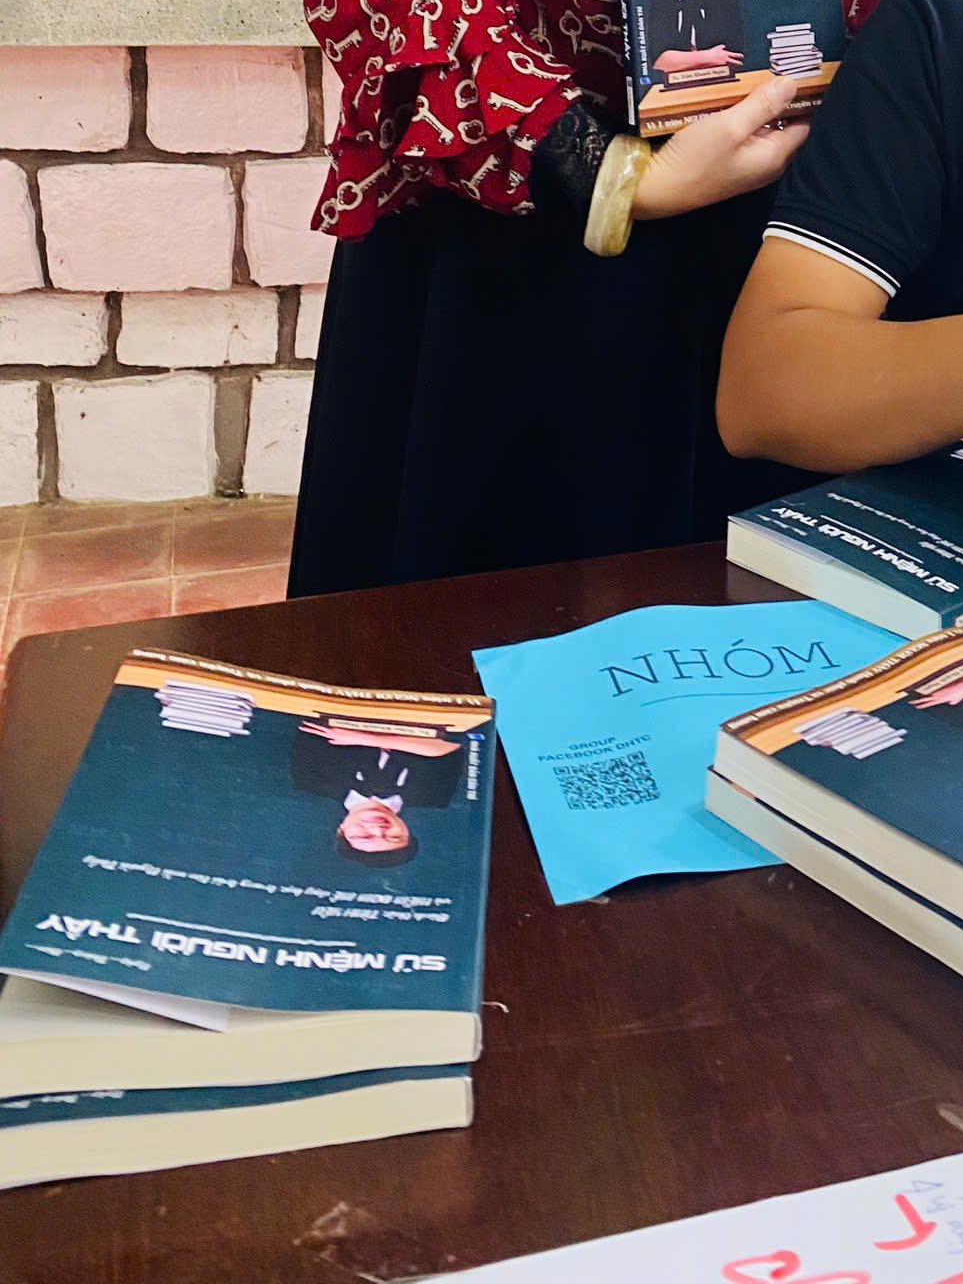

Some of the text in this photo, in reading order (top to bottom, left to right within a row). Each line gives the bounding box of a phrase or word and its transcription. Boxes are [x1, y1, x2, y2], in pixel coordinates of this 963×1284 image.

[873, 549, 929, 577] MỆNH
[600, 639, 840, 698] NHÓM
[538, 747, 613, 761] FACEBOOK
[568, 736, 616, 751] GROUP
[38, 915, 147, 942] THẦY
[152, 932, 270, 962] NGƯỜI
[276, 950, 385, 972] MỆNH
[393, 954, 446, 972] SỨ
